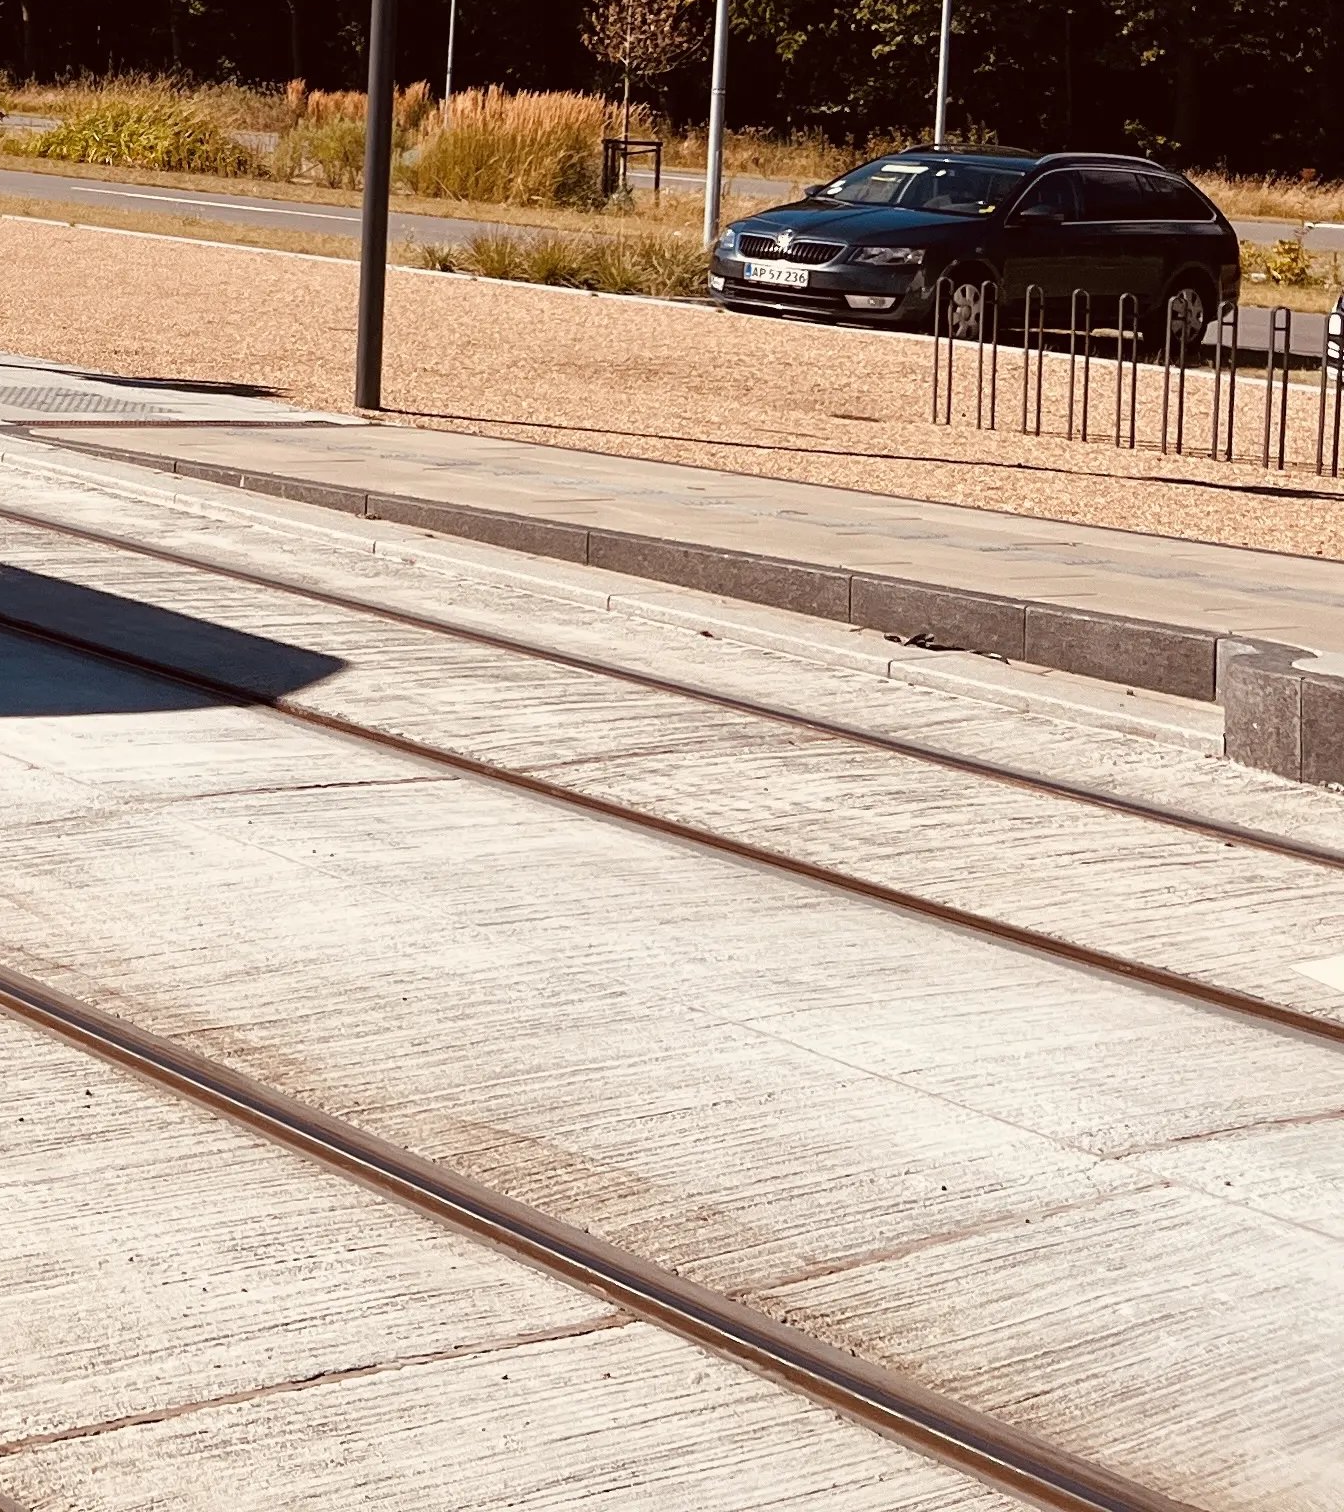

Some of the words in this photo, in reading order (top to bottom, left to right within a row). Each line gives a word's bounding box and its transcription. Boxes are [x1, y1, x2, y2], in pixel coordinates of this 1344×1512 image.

[752, 267, 766, 278] AP
[768, 269, 783, 281] 57
[784, 271, 806, 283] 236
